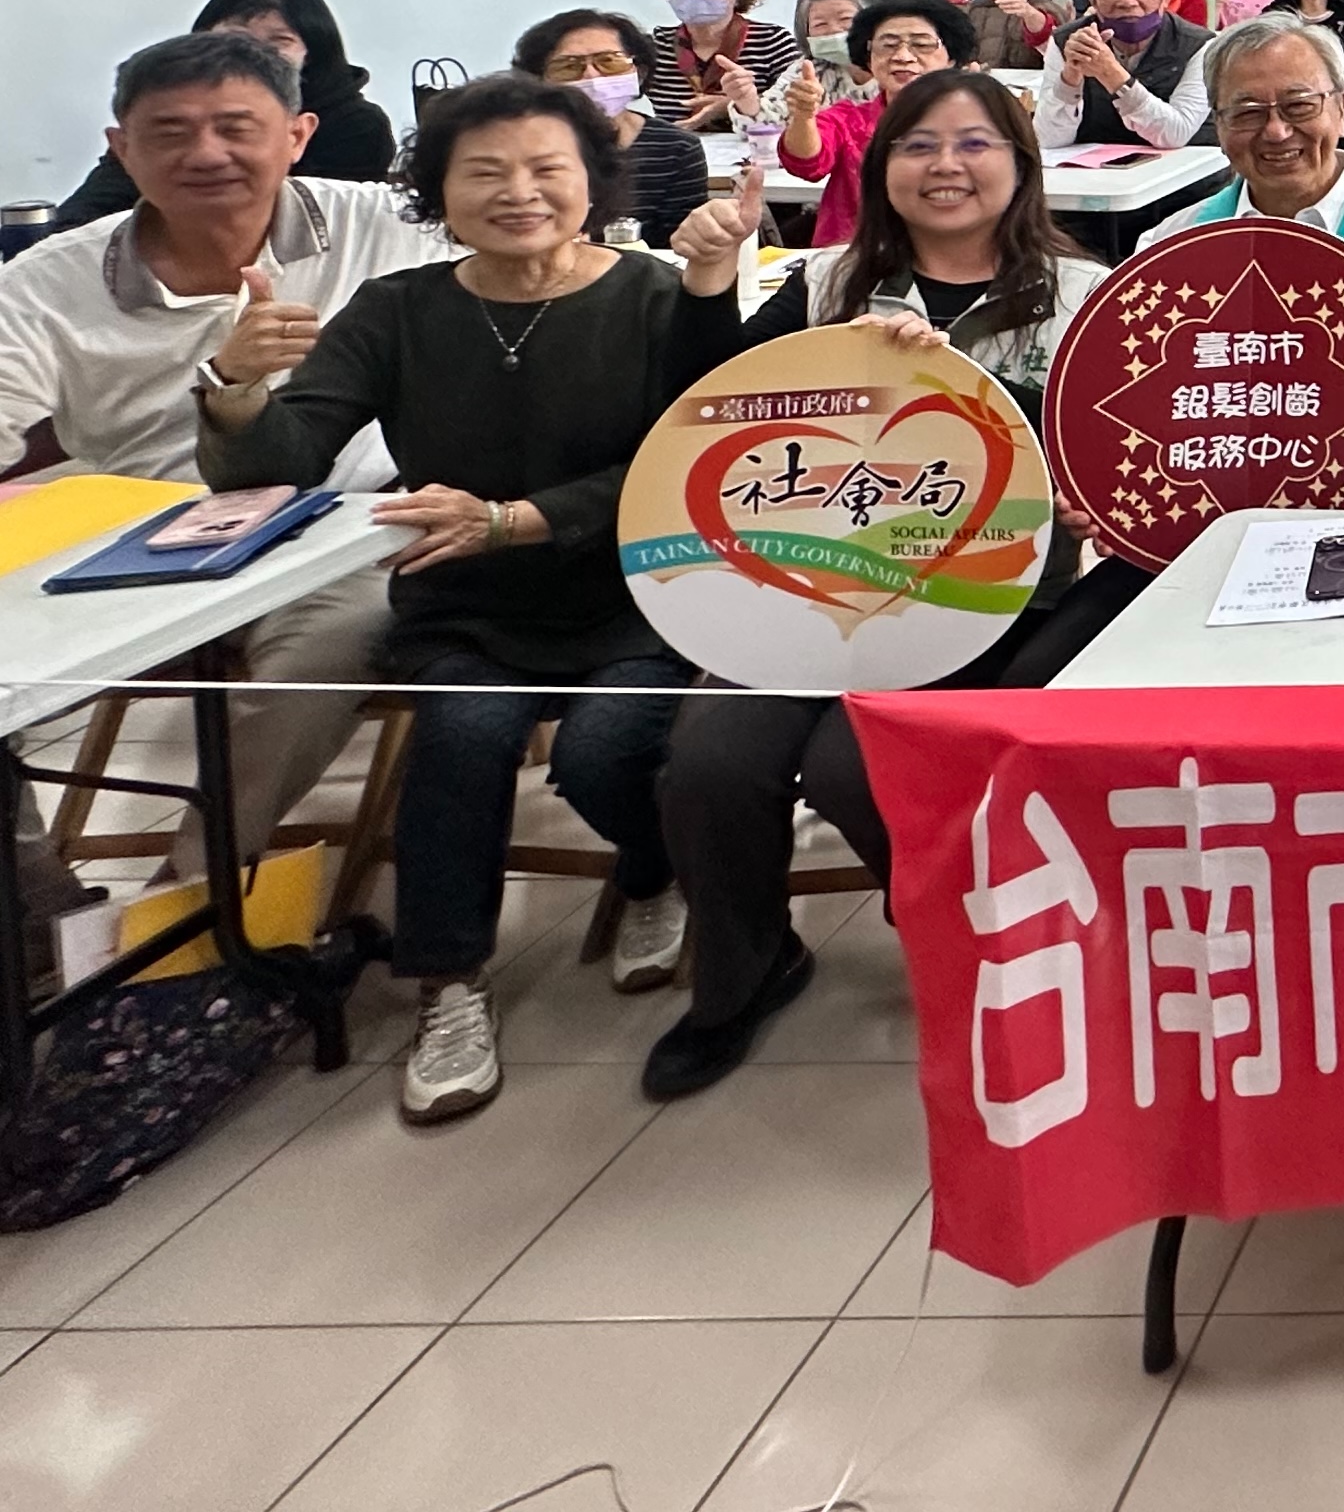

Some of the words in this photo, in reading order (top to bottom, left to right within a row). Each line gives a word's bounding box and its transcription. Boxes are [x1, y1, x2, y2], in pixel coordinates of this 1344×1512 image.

[1192, 330, 1304, 369] 臺南市
[718, 391, 856, 421] 臺南市政府
[1170, 381, 1321, 420] 銀髮創齡
[1168, 433, 1320, 472] 服務中心
[721, 441, 966, 527] 社會局
[890, 526, 947, 540] SOCIAL
[953, 527, 1016, 543] AFFAIRS
[890, 543, 955, 557] BUREAU
[634, 537, 729, 566] TAINAN
[733, 538, 792, 559] CITY
[791, 539, 933, 596] GOVERNMENT
